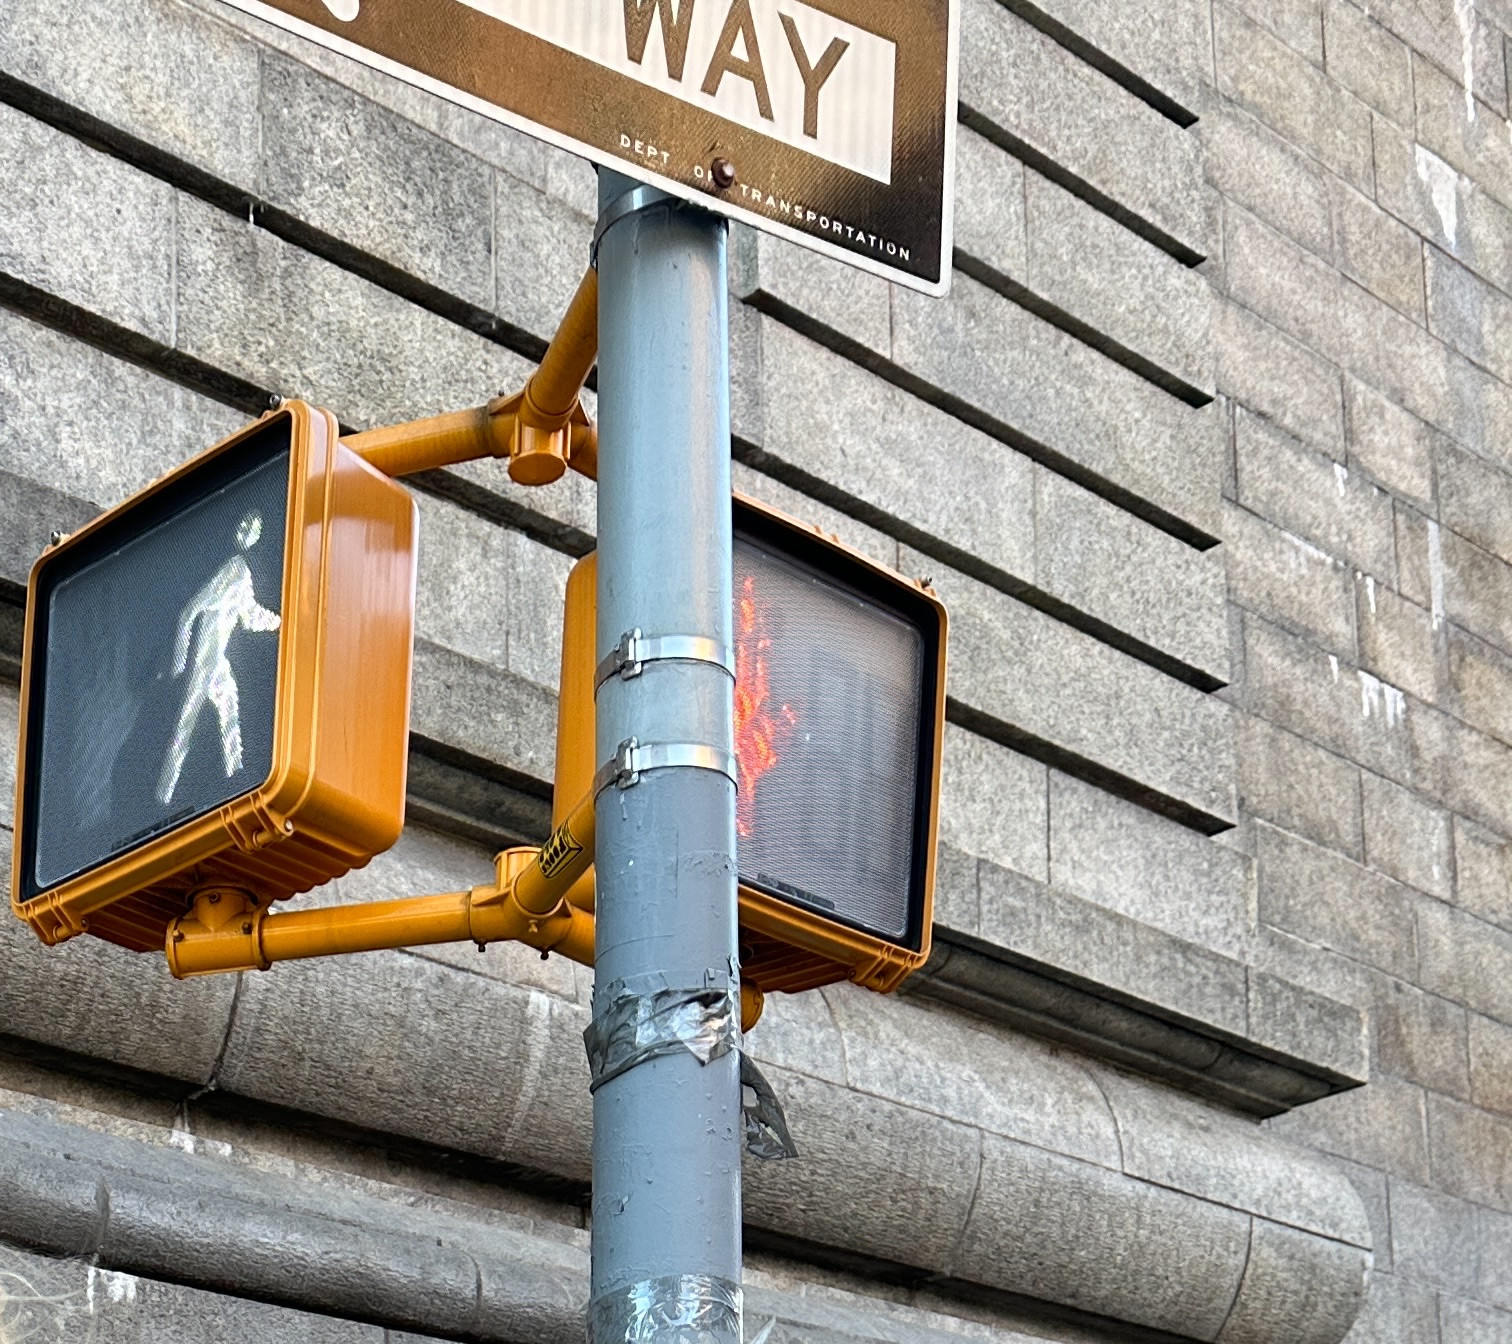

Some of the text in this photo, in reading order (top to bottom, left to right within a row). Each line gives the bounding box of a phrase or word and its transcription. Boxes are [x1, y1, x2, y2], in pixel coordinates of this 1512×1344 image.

[623, 0, 850, 139] WAY
[620, 134, 670, 164] DEPT
[740, 184, 910, 261] TRANSPORTATION
